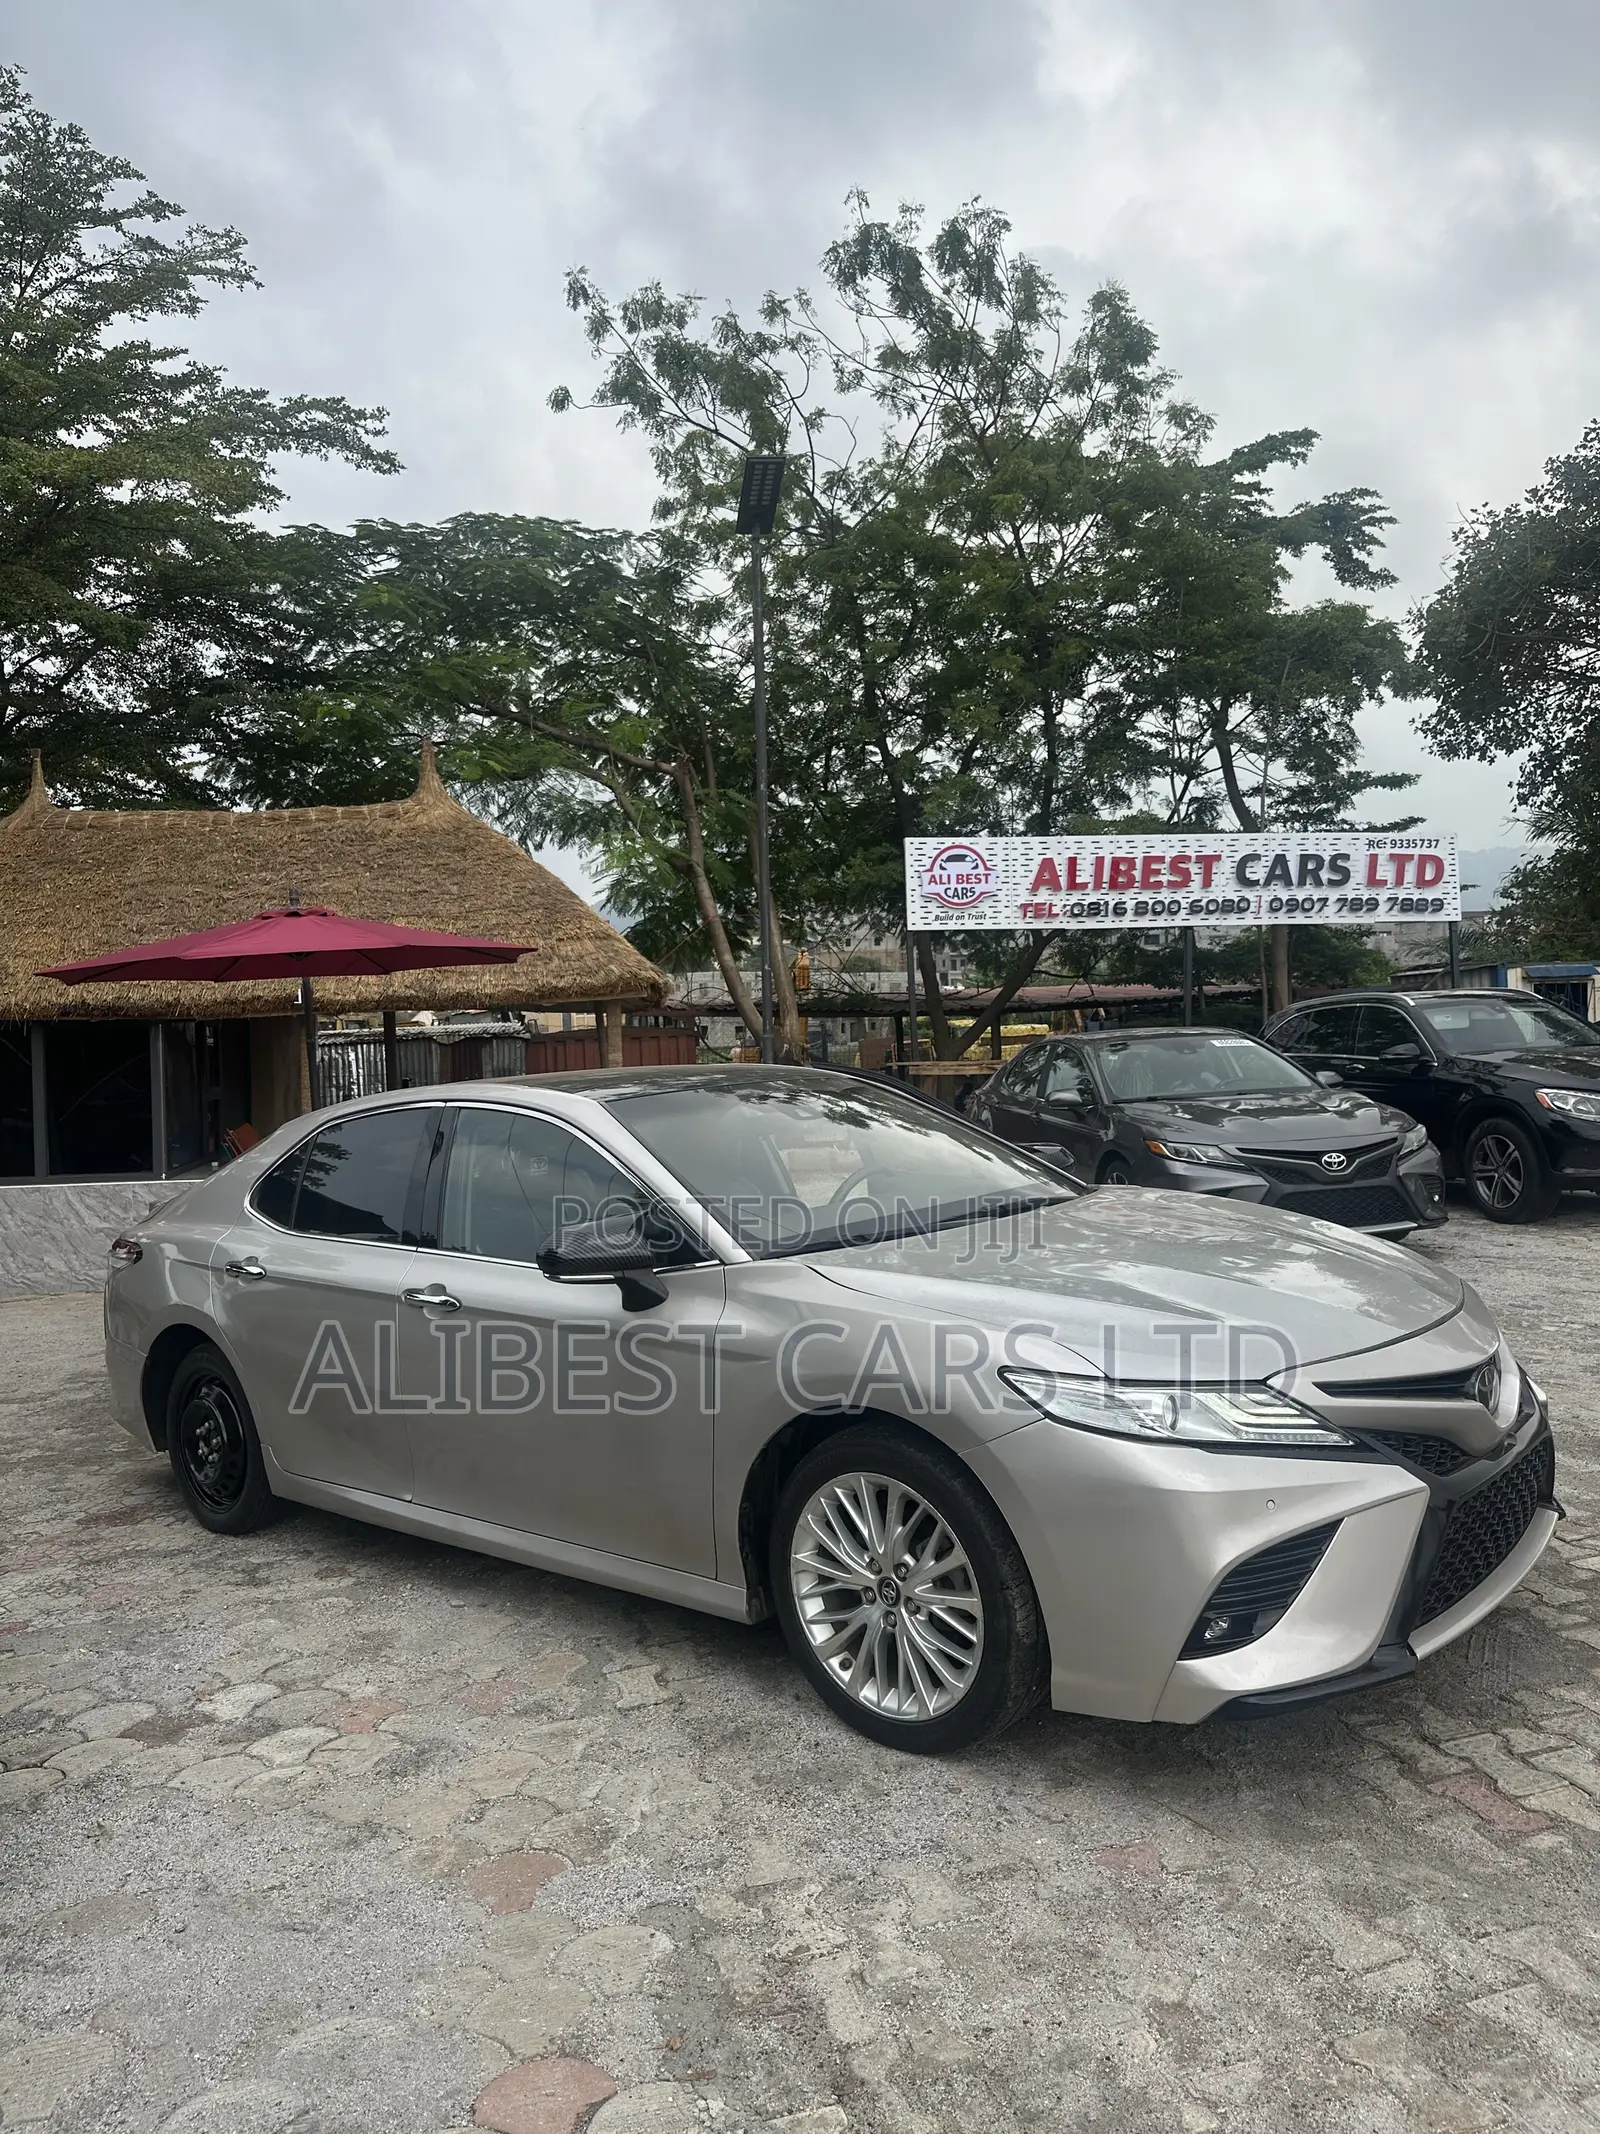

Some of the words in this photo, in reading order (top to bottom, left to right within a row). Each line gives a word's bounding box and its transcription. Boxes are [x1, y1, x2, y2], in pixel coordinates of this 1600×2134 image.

[1390, 839, 1440, 849] 9335737
[1029, 854, 1222, 893] ALIBEST
[1235, 852, 1352, 888] CARS
[1365, 852, 1445, 888] LTD
[928, 874, 951, 885] ALI
[956, 873, 991, 884] BEST
[944, 887, 976, 900] CARS
[1070, 901, 1128, 917] 0816
[1134, 899, 1182, 916] 800
[1189, 896, 1250, 914] 6080
[1269, 896, 1329, 913] 0907
[1335, 897, 1380, 913] 789
[1386, 897, 1445, 913] 7889
[934, 914, 954, 922] Build
[968, 913, 987, 921] Trust
